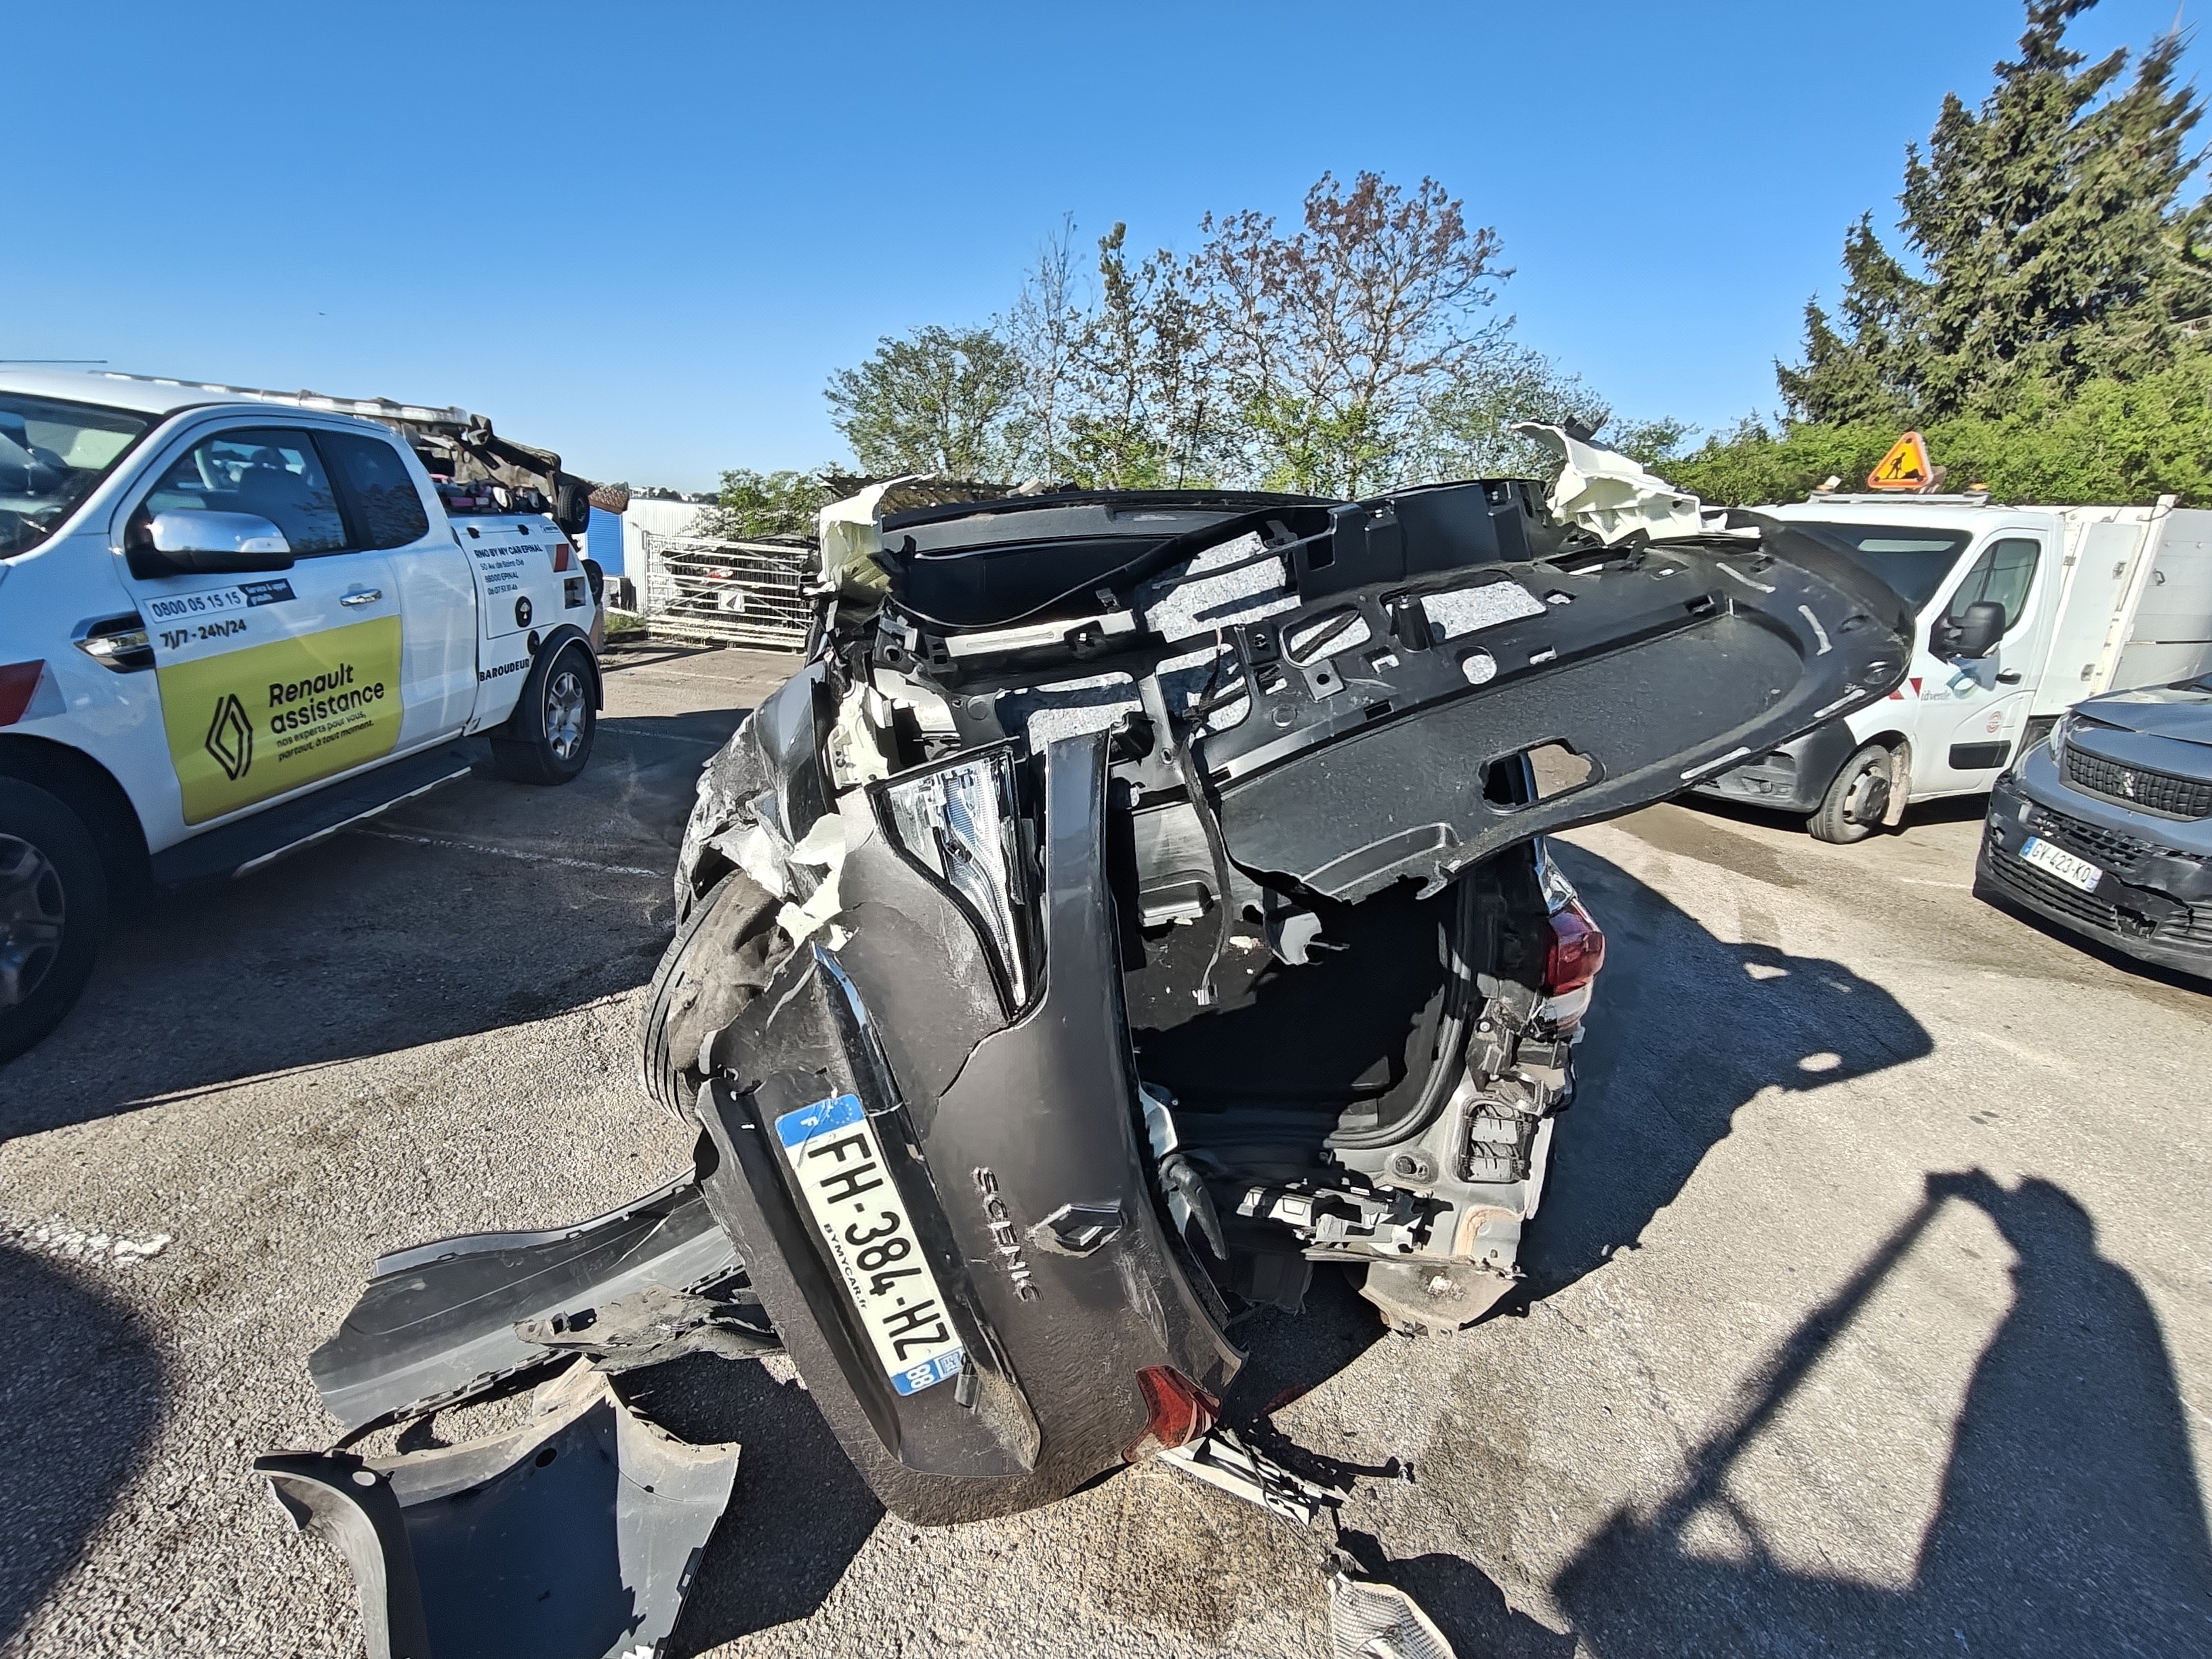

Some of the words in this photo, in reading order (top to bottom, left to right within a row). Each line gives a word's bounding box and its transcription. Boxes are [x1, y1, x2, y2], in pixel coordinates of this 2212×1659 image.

[497, 547, 509, 556] MY
[508, 546, 523, 555] CAR
[152, 599, 186, 617] 0800
[188, 596, 206, 612] 05
[207, 594, 224, 609] 15
[225, 591, 241, 606] 15
[159, 629, 188, 650] 7j/7
[197, 619, 247, 640] 24h/24
[268, 663, 354, 708] Renault
[479, 658, 530, 682] BAROUDEUR
[270, 682, 385, 735] assistance
[276, 736, 293, 748] nos
[294, 725, 327, 740] experts
[327, 717, 346, 732] pour
[346, 711, 367, 724] vous,
[323, 731, 340, 744] tout
[807, 1133, 951, 1361] FH-384-HZ
[970, 1166, 1044, 1303] SCENIC
[905, 1364, 935, 1389] 88
